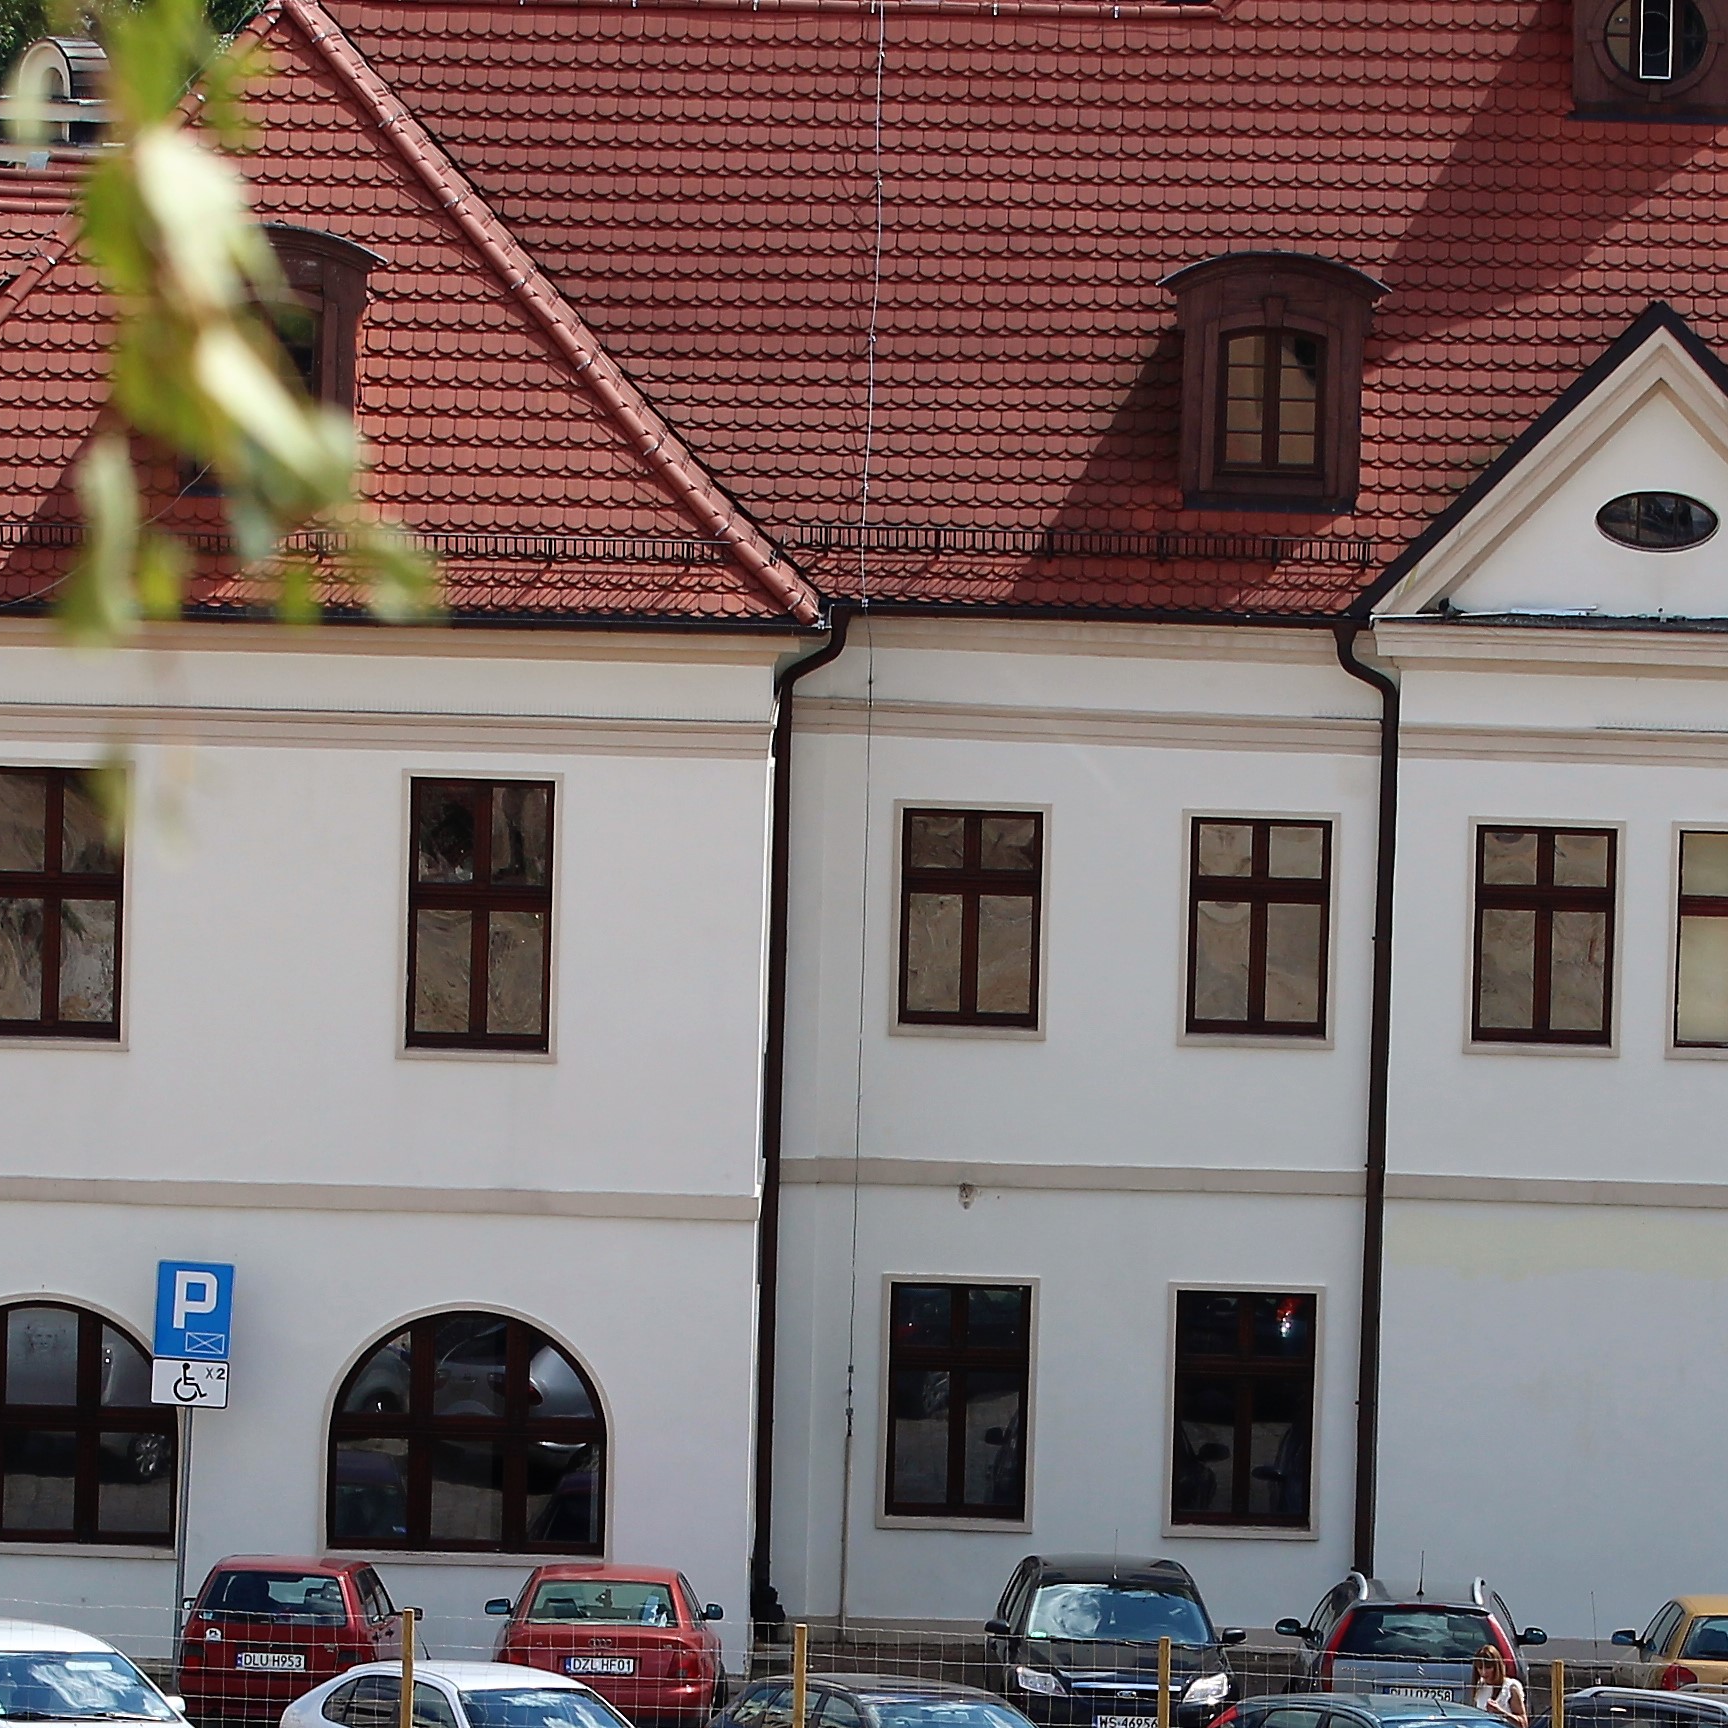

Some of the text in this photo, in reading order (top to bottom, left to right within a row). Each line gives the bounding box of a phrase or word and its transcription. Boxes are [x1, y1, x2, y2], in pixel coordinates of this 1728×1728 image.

[173, 1270, 218, 1329] P
[244, 1654, 302, 1667] DLU H953
[573, 1658, 631, 1671] DZL HF01
[1099, 1717, 1158, 1728] WS 46956
